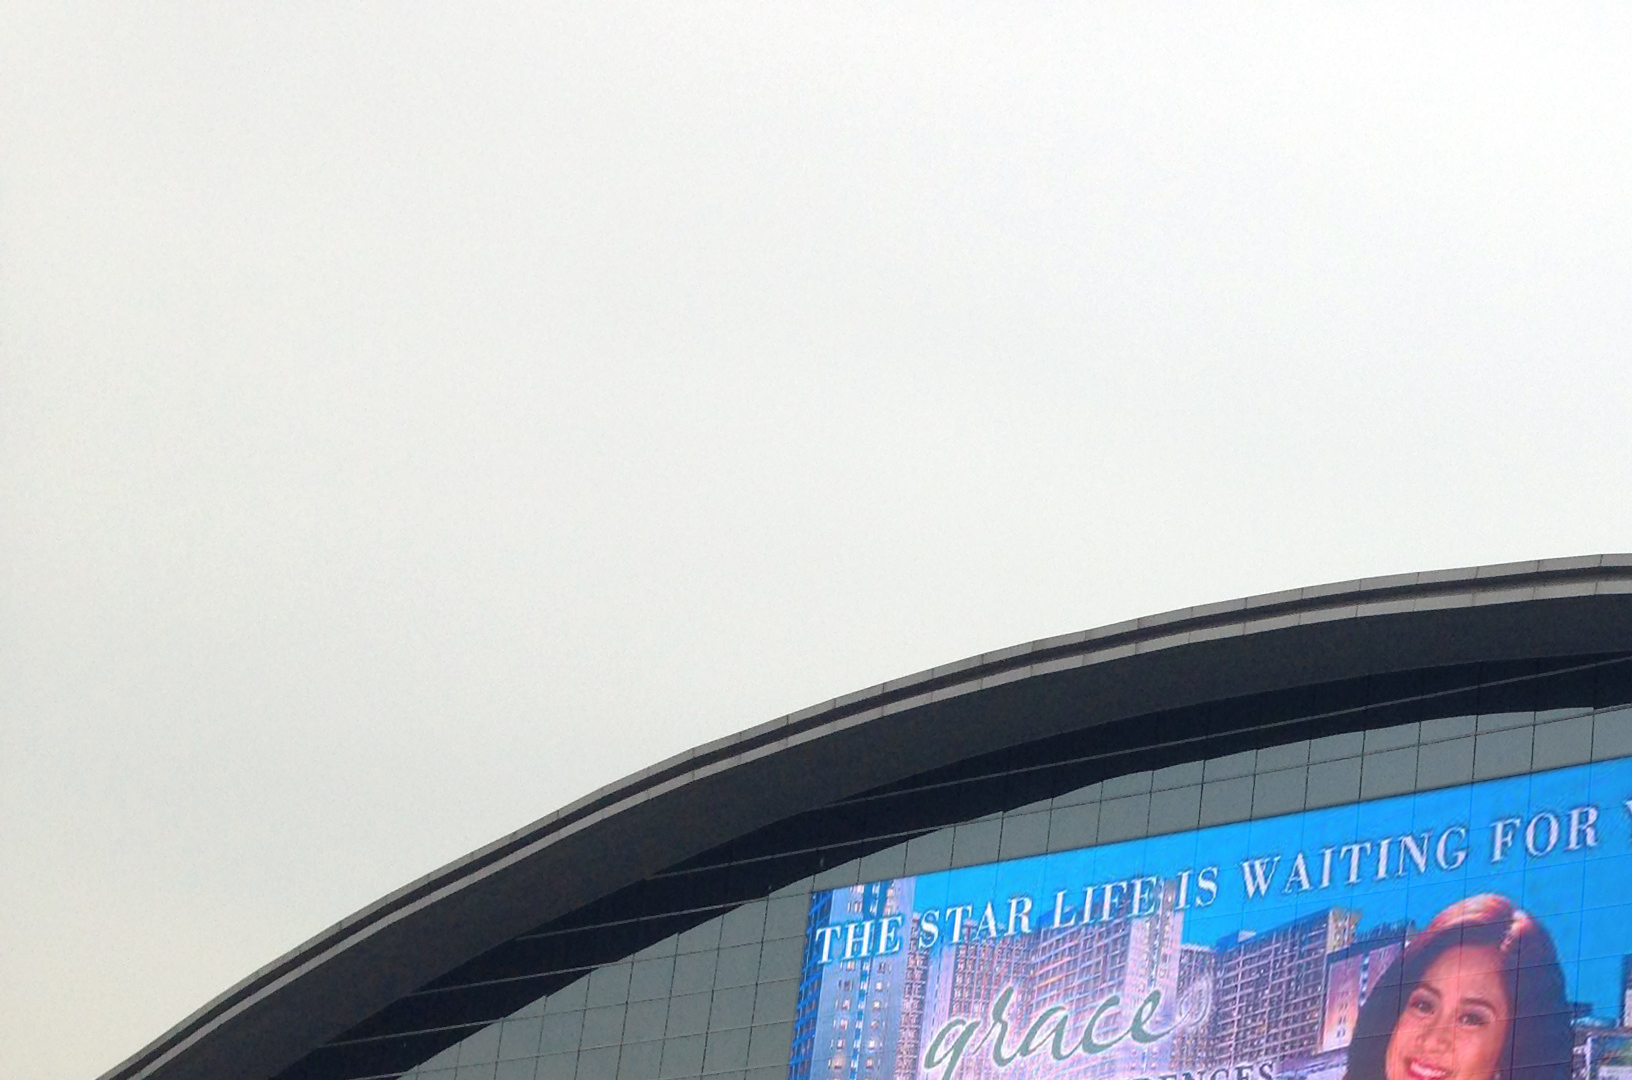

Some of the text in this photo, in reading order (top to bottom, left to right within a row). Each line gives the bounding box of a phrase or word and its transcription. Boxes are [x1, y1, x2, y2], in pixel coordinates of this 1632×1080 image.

[815, 915, 903, 964] THE
[918, 895, 1033, 949] STAR
[1052, 876, 1160, 930] LIFE
[1174, 865, 1221, 912] IS
[1240, 826, 1470, 900] WAITING
[1490, 805, 1600, 864] FOR
